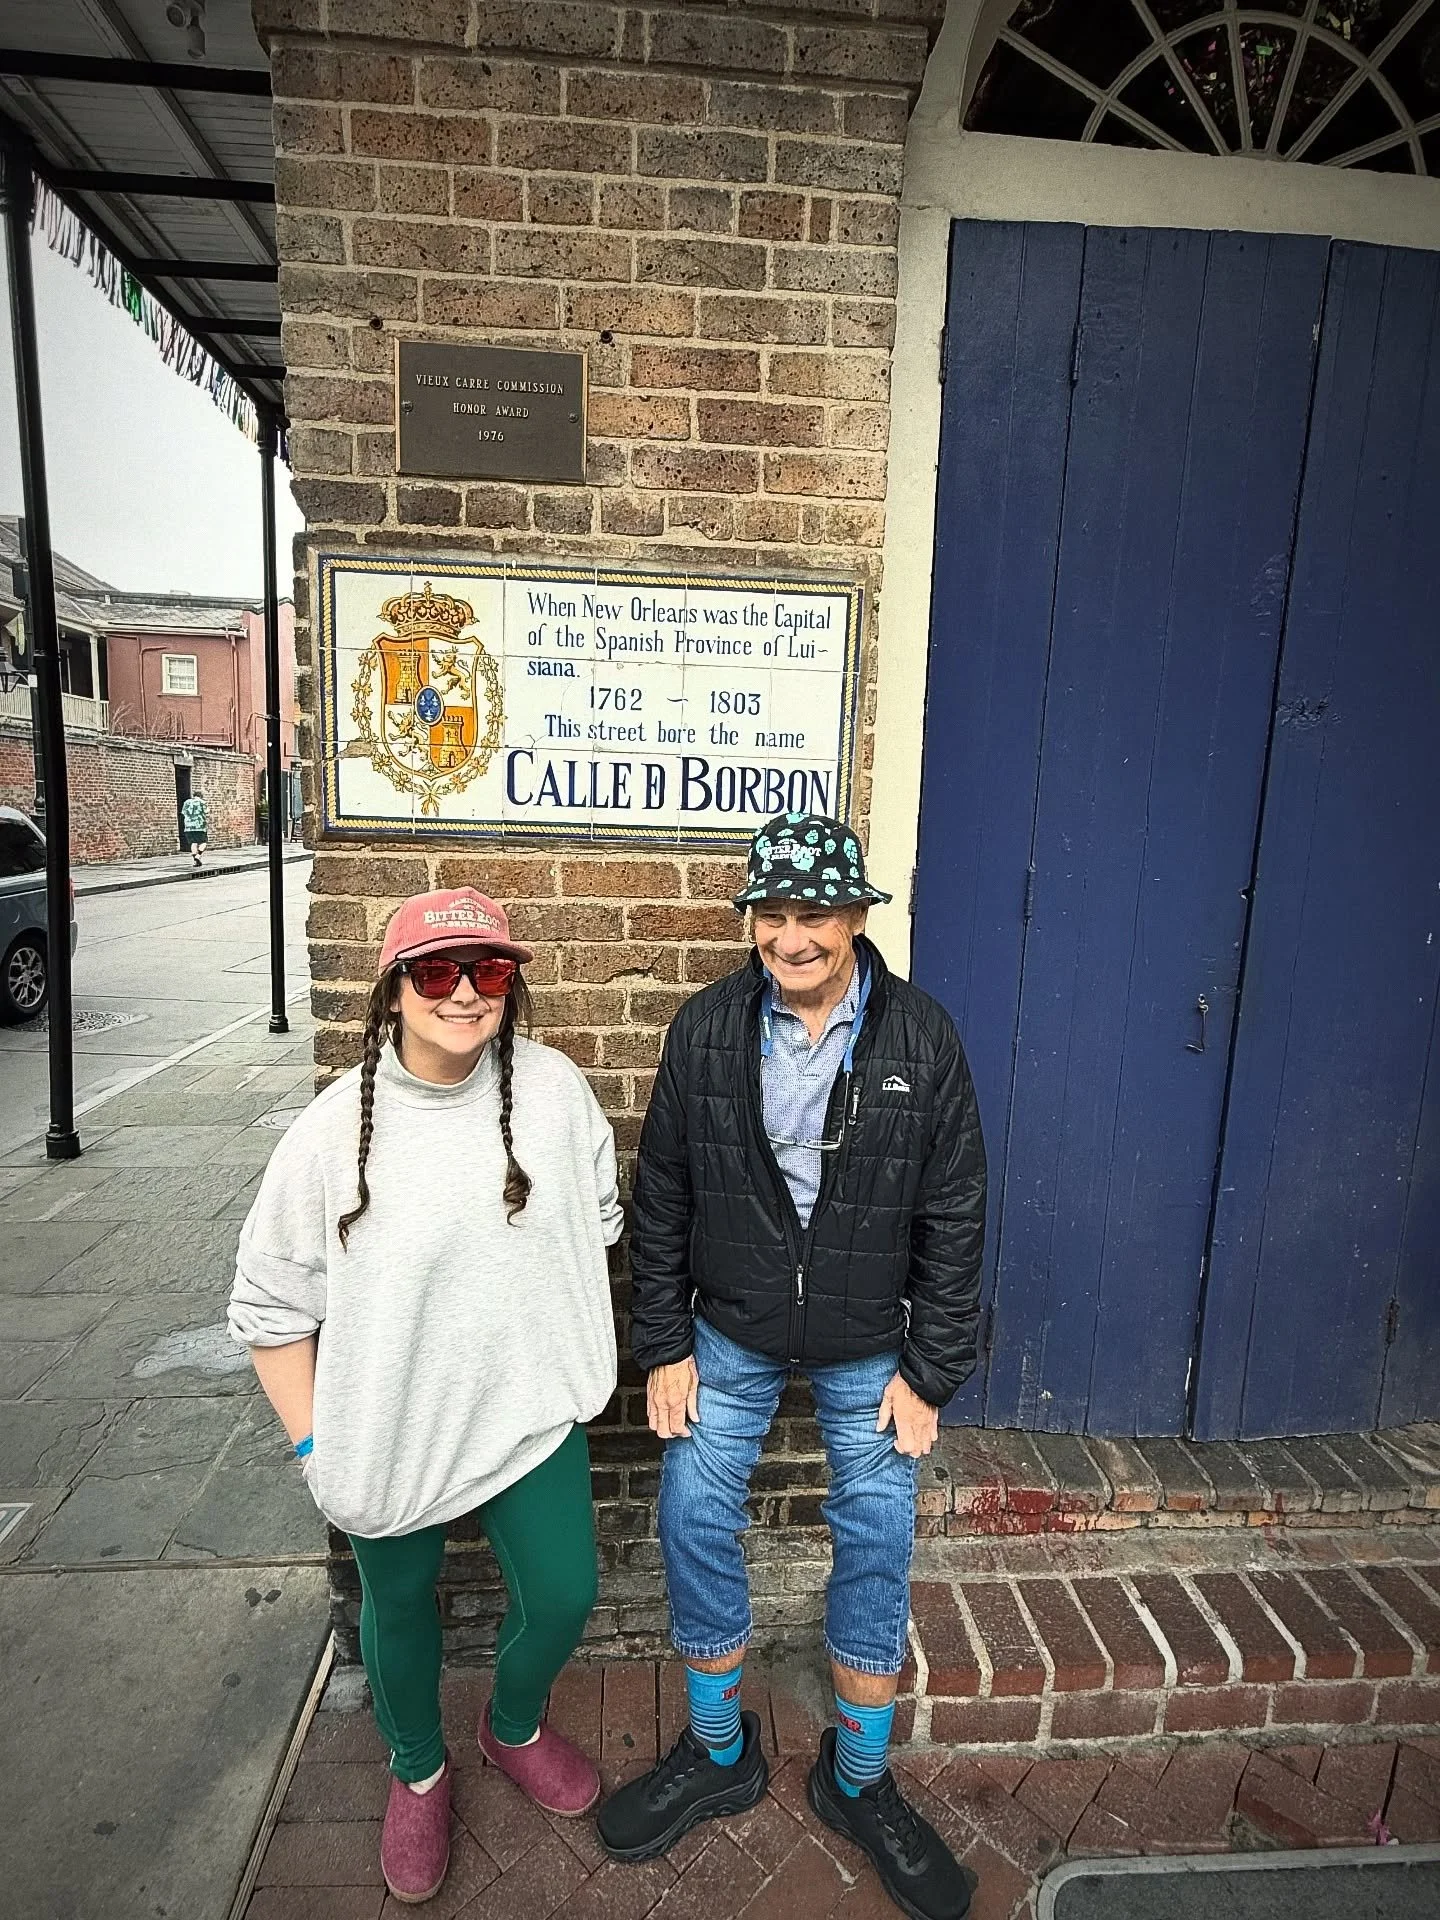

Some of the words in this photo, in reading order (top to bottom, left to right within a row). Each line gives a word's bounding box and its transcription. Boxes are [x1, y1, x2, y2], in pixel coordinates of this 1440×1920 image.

[415, 374, 450, 387] VIEUX
[455, 377, 490, 390] CARRE
[497, 380, 565, 395] COMMISSION
[453, 402, 487, 415] HONOR
[495, 405, 530, 419] AWARD
[478, 429, 505, 442] 1976
[527, 591, 576, 618] When
[582, 593, 624, 620] New
[631, 596, 698, 623] Orleans
[703, 608, 738, 625] was
[743, 602, 768, 627] the
[774, 603, 831, 637] Capital
[528, 623, 547, 646] of
[555, 624, 585, 648] the
[595, 626, 664, 660] Spanish
[674, 630, 752, 656] Province
[763, 634, 785, 657] of
[527, 660, 581, 678] siana.
[590, 685, 643, 711] 1762
[710, 690, 762, 716] 1803
[544, 714, 581, 738] This
[587, 720, 647, 742] street
[657, 720, 696, 744] bore
[709, 721, 739, 746] the
[755, 731, 805, 749] name
[506, 749, 632, 809] CALLE
[675, 756, 833, 816] BORBON
[423, 909, 475, 925] BITTER
